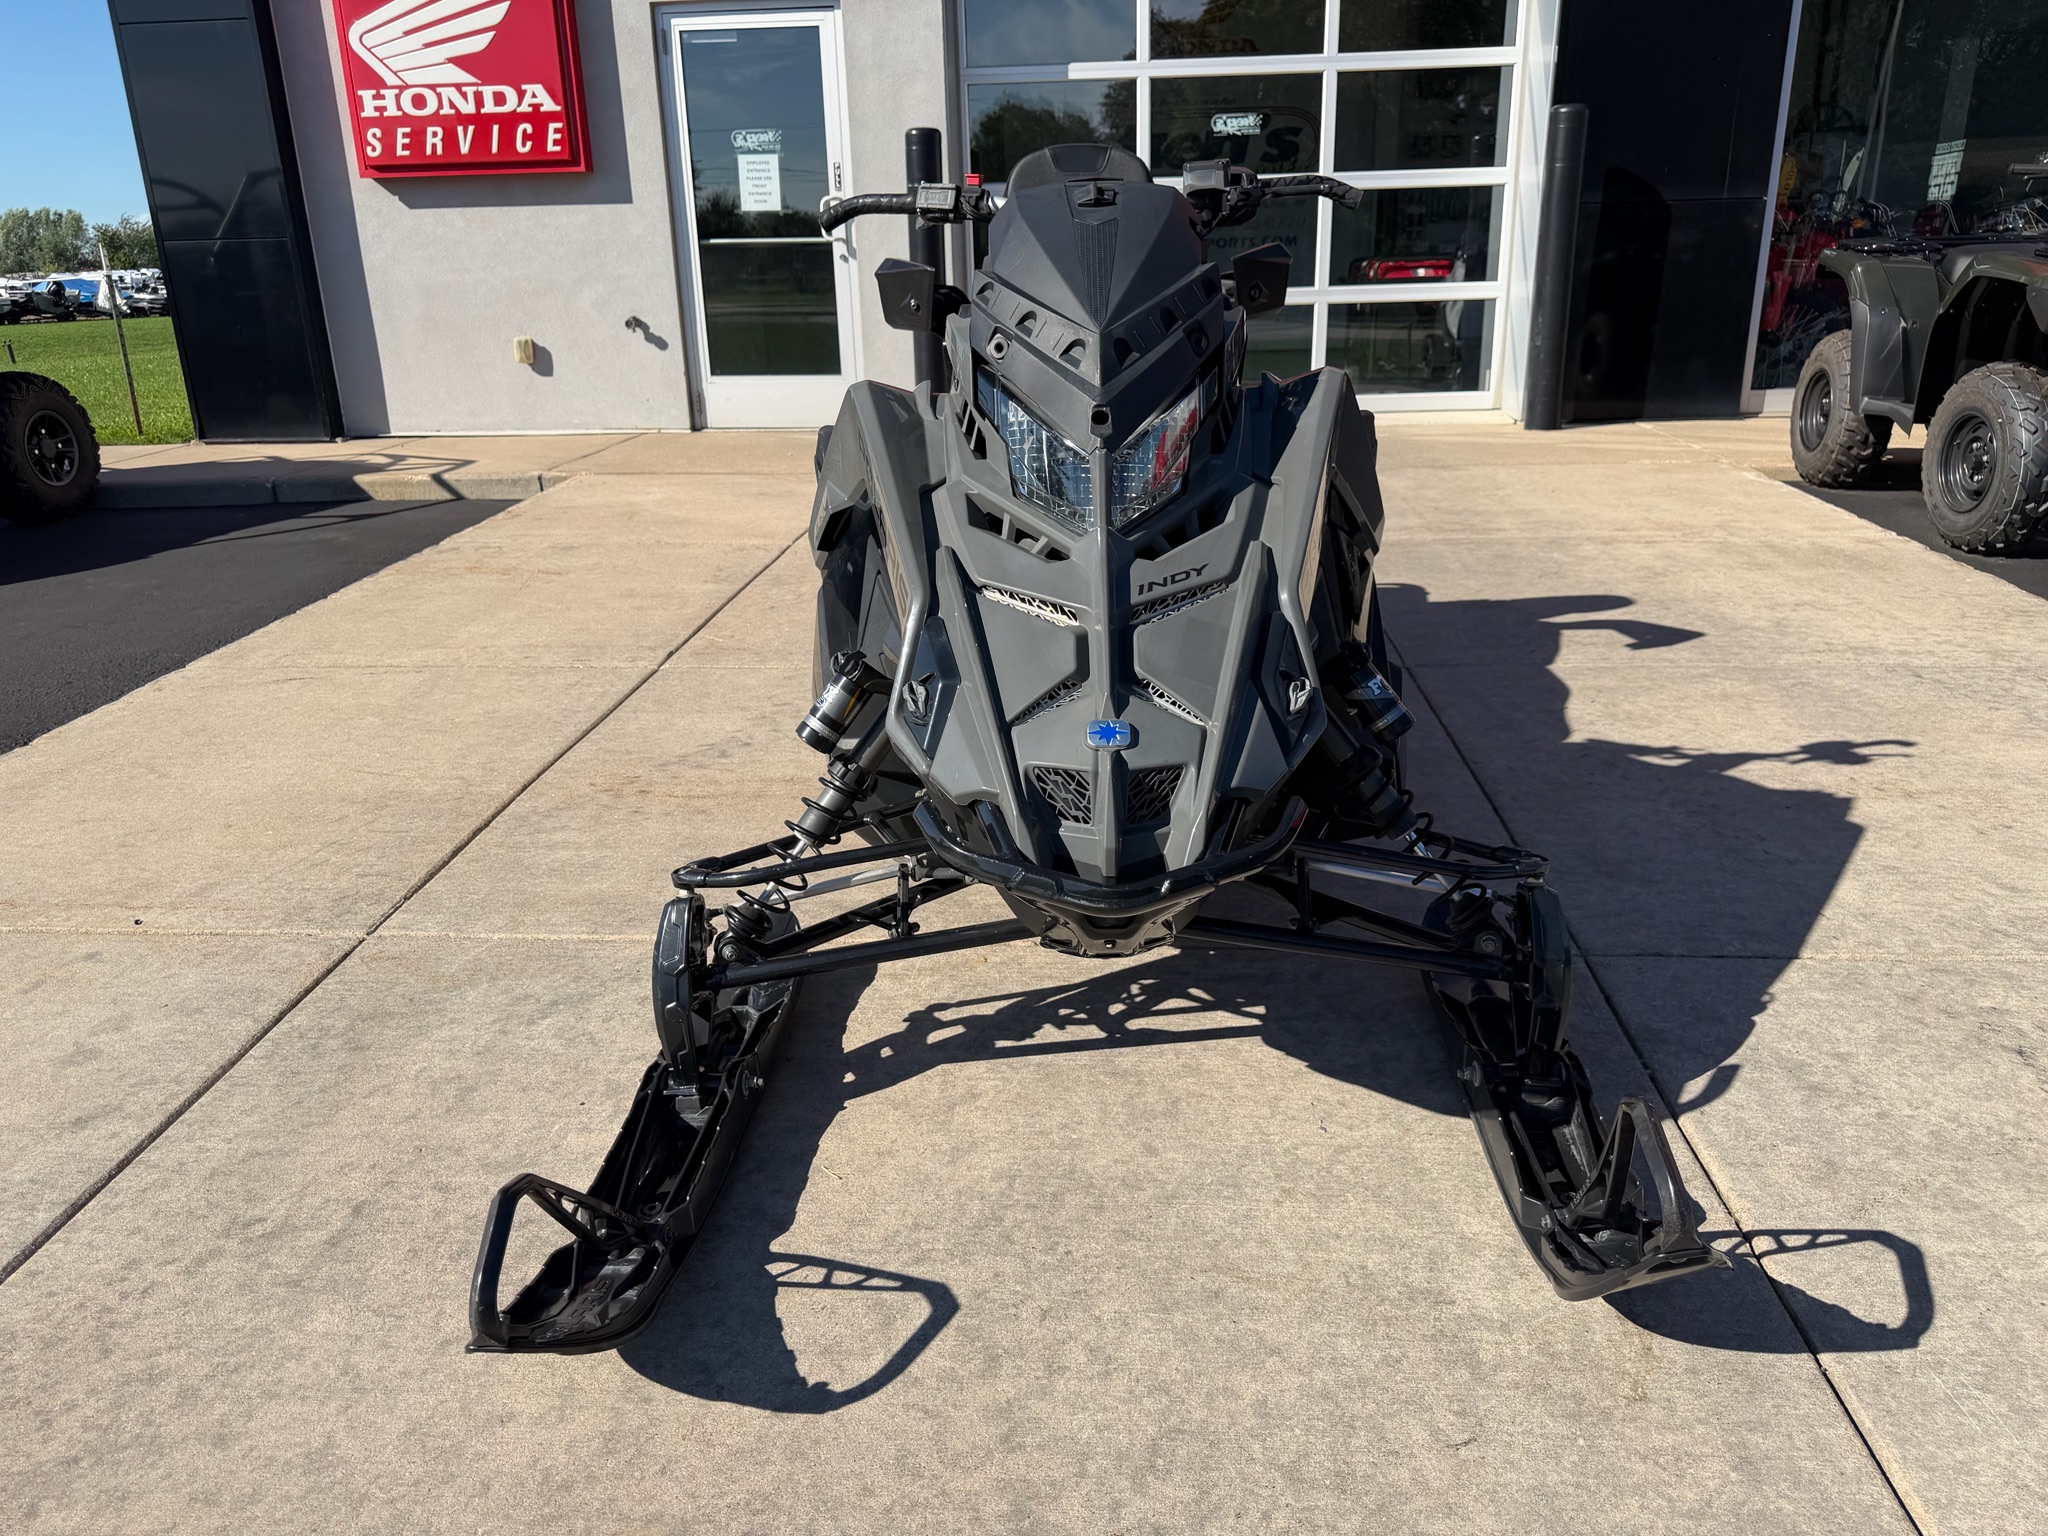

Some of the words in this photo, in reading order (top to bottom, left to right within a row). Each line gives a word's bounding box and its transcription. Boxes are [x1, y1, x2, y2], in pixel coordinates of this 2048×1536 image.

[357, 83, 562, 118] HONDA
[366, 122, 564, 158] SERVICE
[1137, 562, 1210, 596] INDY
